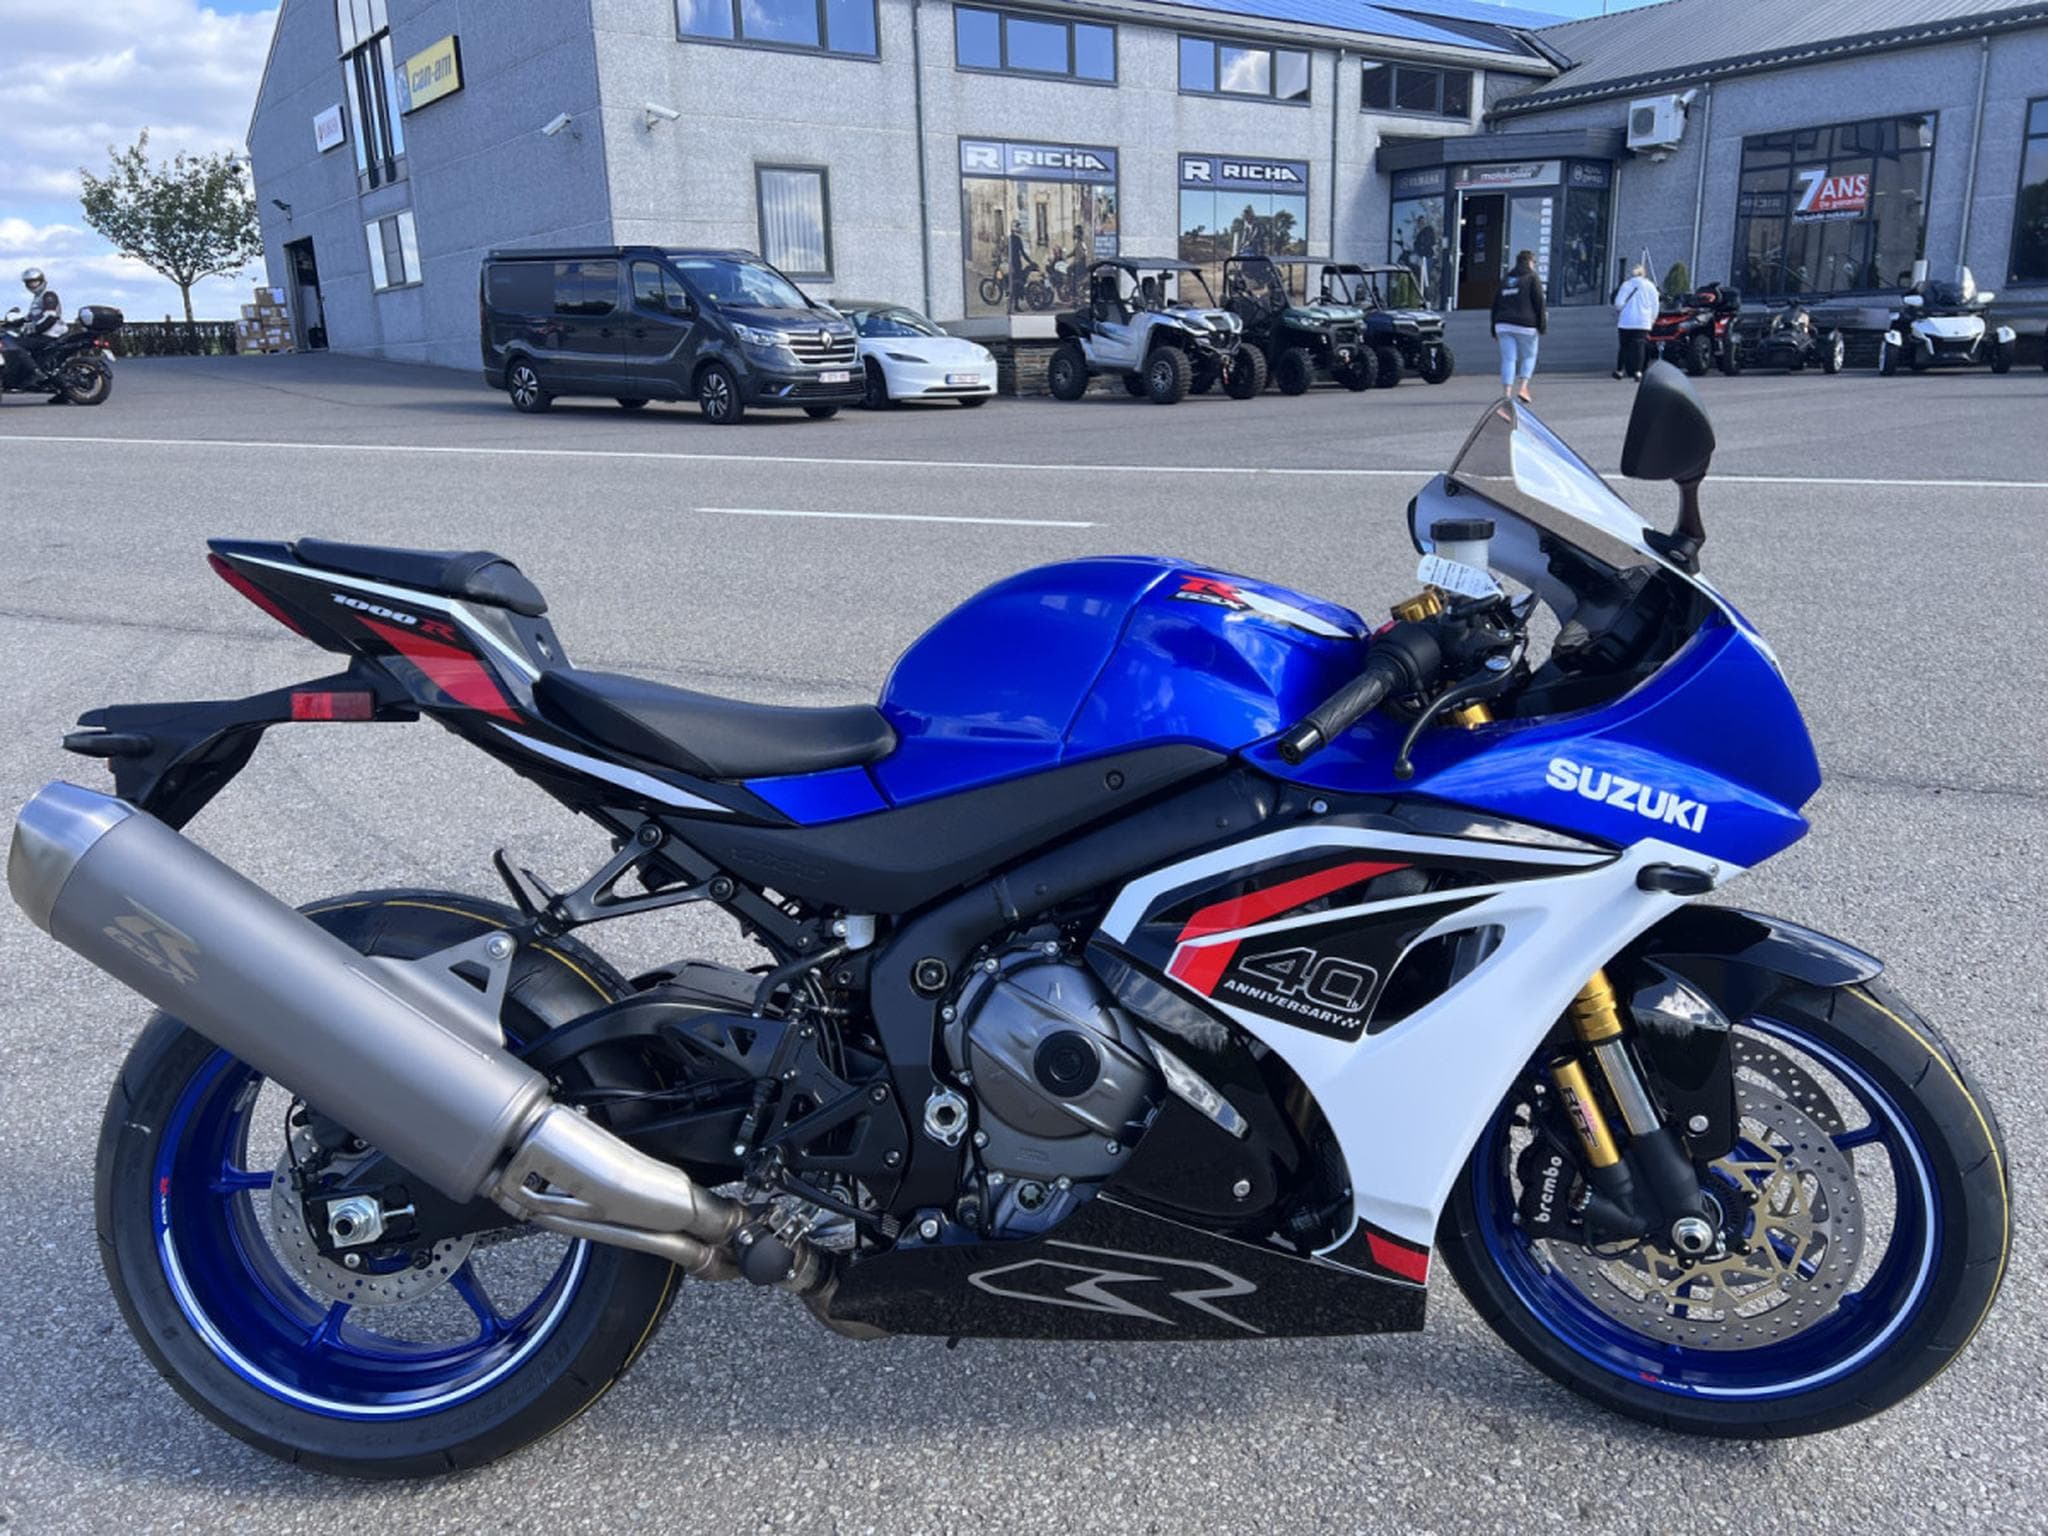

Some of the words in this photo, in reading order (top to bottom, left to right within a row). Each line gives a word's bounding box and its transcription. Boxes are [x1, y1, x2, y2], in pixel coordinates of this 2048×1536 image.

[411, 53, 452, 93] can-am
[966, 145, 1000, 169] R
[1012, 149, 1108, 172] RICHA
[1183, 160, 1213, 182] R
[1222, 163, 1302, 182] RICHA
[1820, 174, 1867, 200] ANS
[330, 593, 418, 626] 1000
[1545, 757, 1708, 834] SUZUKI
[1238, 946, 1379, 1013] 40
[1223, 979, 1343, 1024] ANNIVERSARY
[1533, 1156, 1563, 1223] brembo
